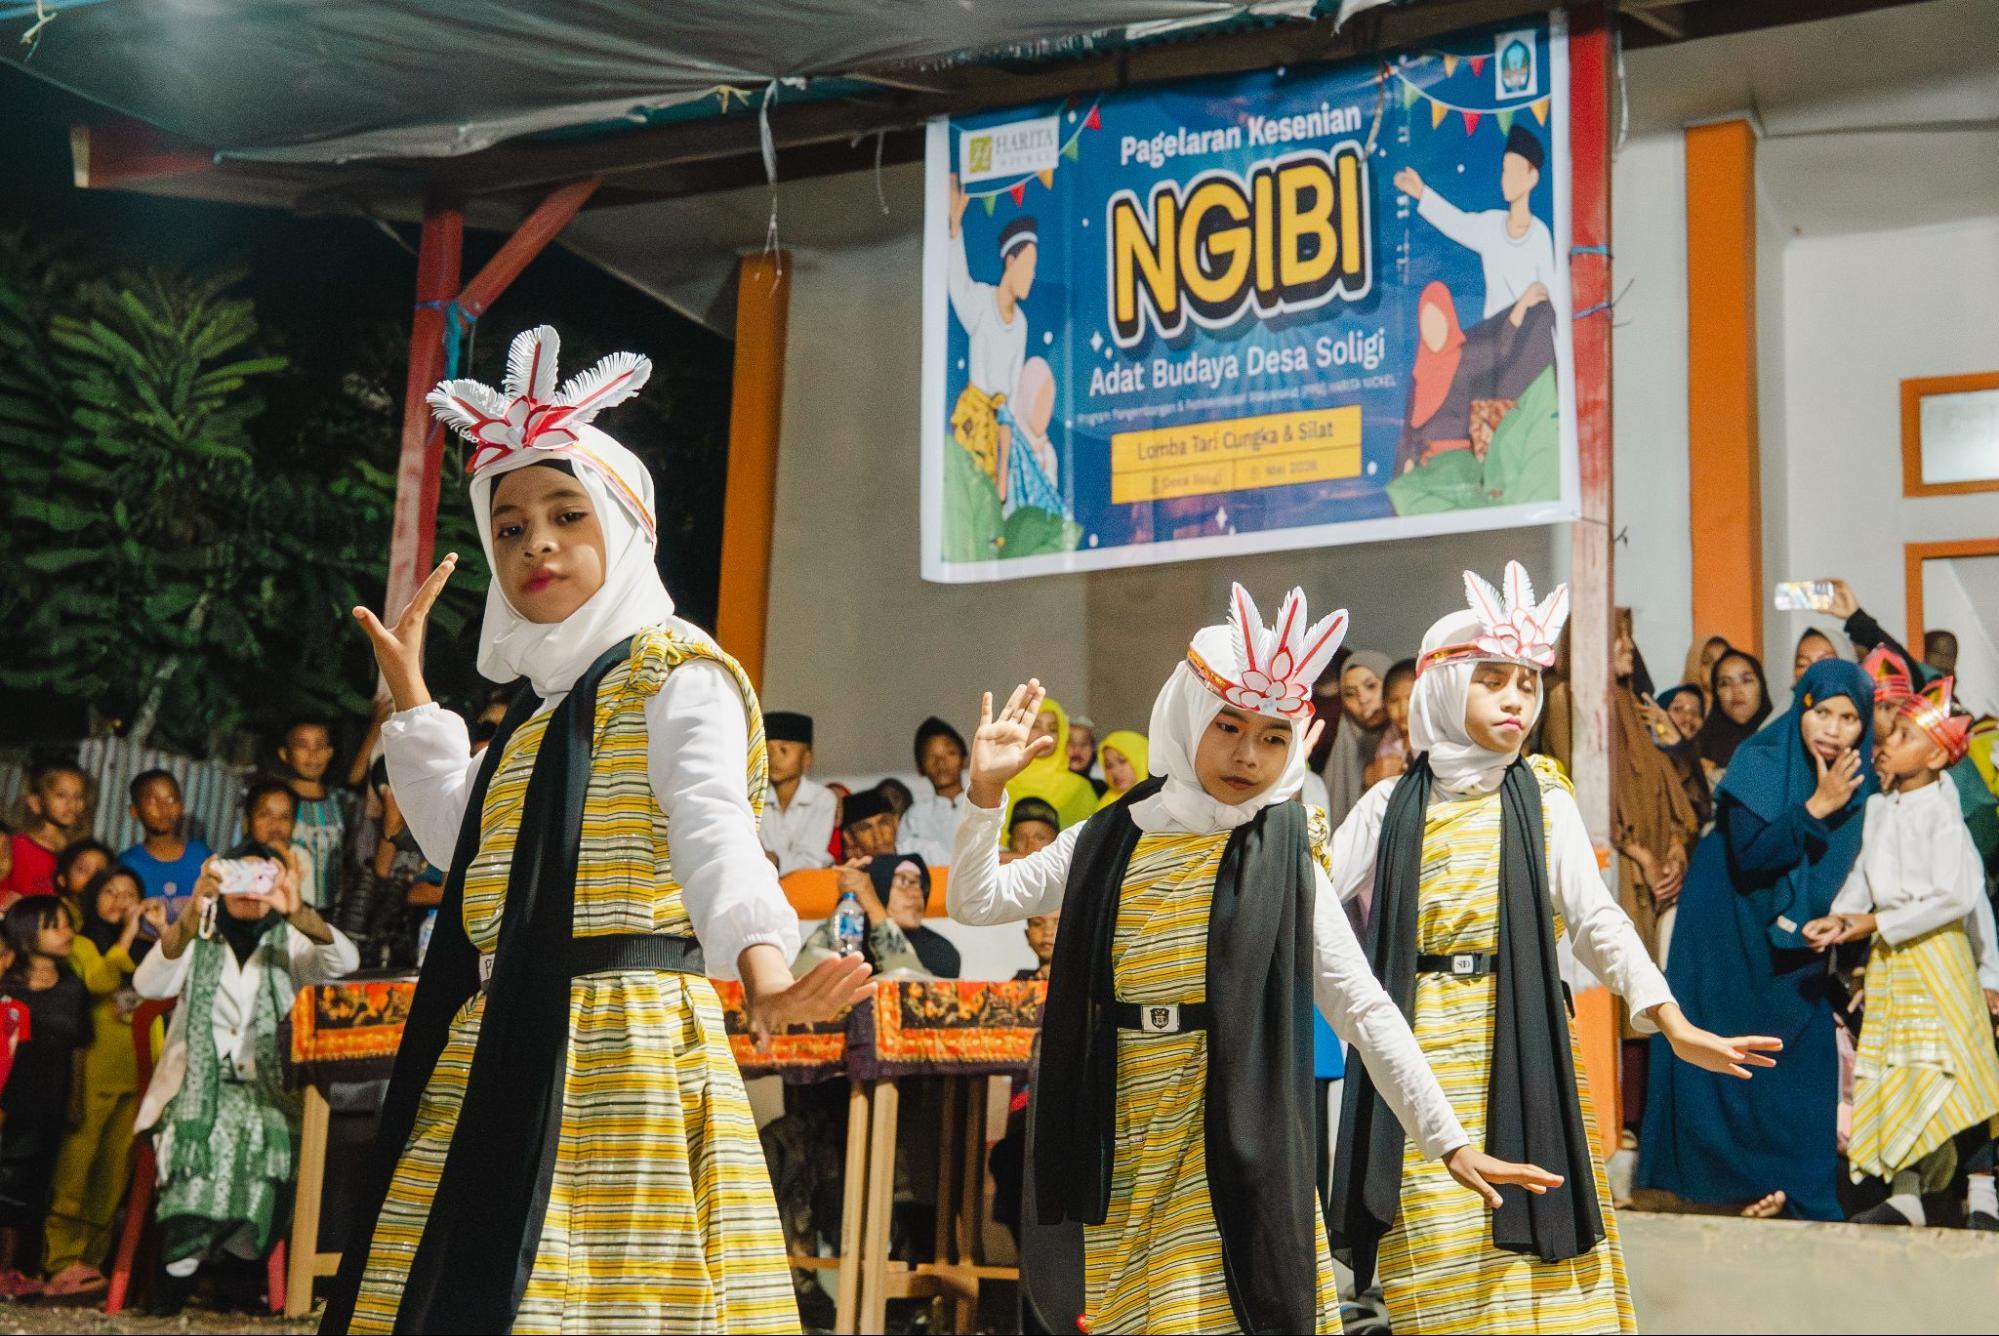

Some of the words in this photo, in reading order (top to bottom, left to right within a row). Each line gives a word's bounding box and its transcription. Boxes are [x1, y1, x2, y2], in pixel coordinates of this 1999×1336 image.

[995, 129, 1053, 155] HARITA
[1120, 126, 1241, 168] Pagelaran
[1247, 102, 1362, 147] Kesenian
[1110, 146, 1368, 338] NGIBI
[1089, 362, 1145, 397] Adat
[1152, 351, 1239, 389] Budaya
[1247, 345, 1308, 376] Desa
[1315, 327, 1386, 371] Soligi
[1137, 437, 1187, 461] Lomba
[1192, 433, 1219, 454] Tari
[1223, 426, 1278, 452] Cungka
[1283, 423, 1293, 442] &
[1299, 420, 1334, 440] Silat
